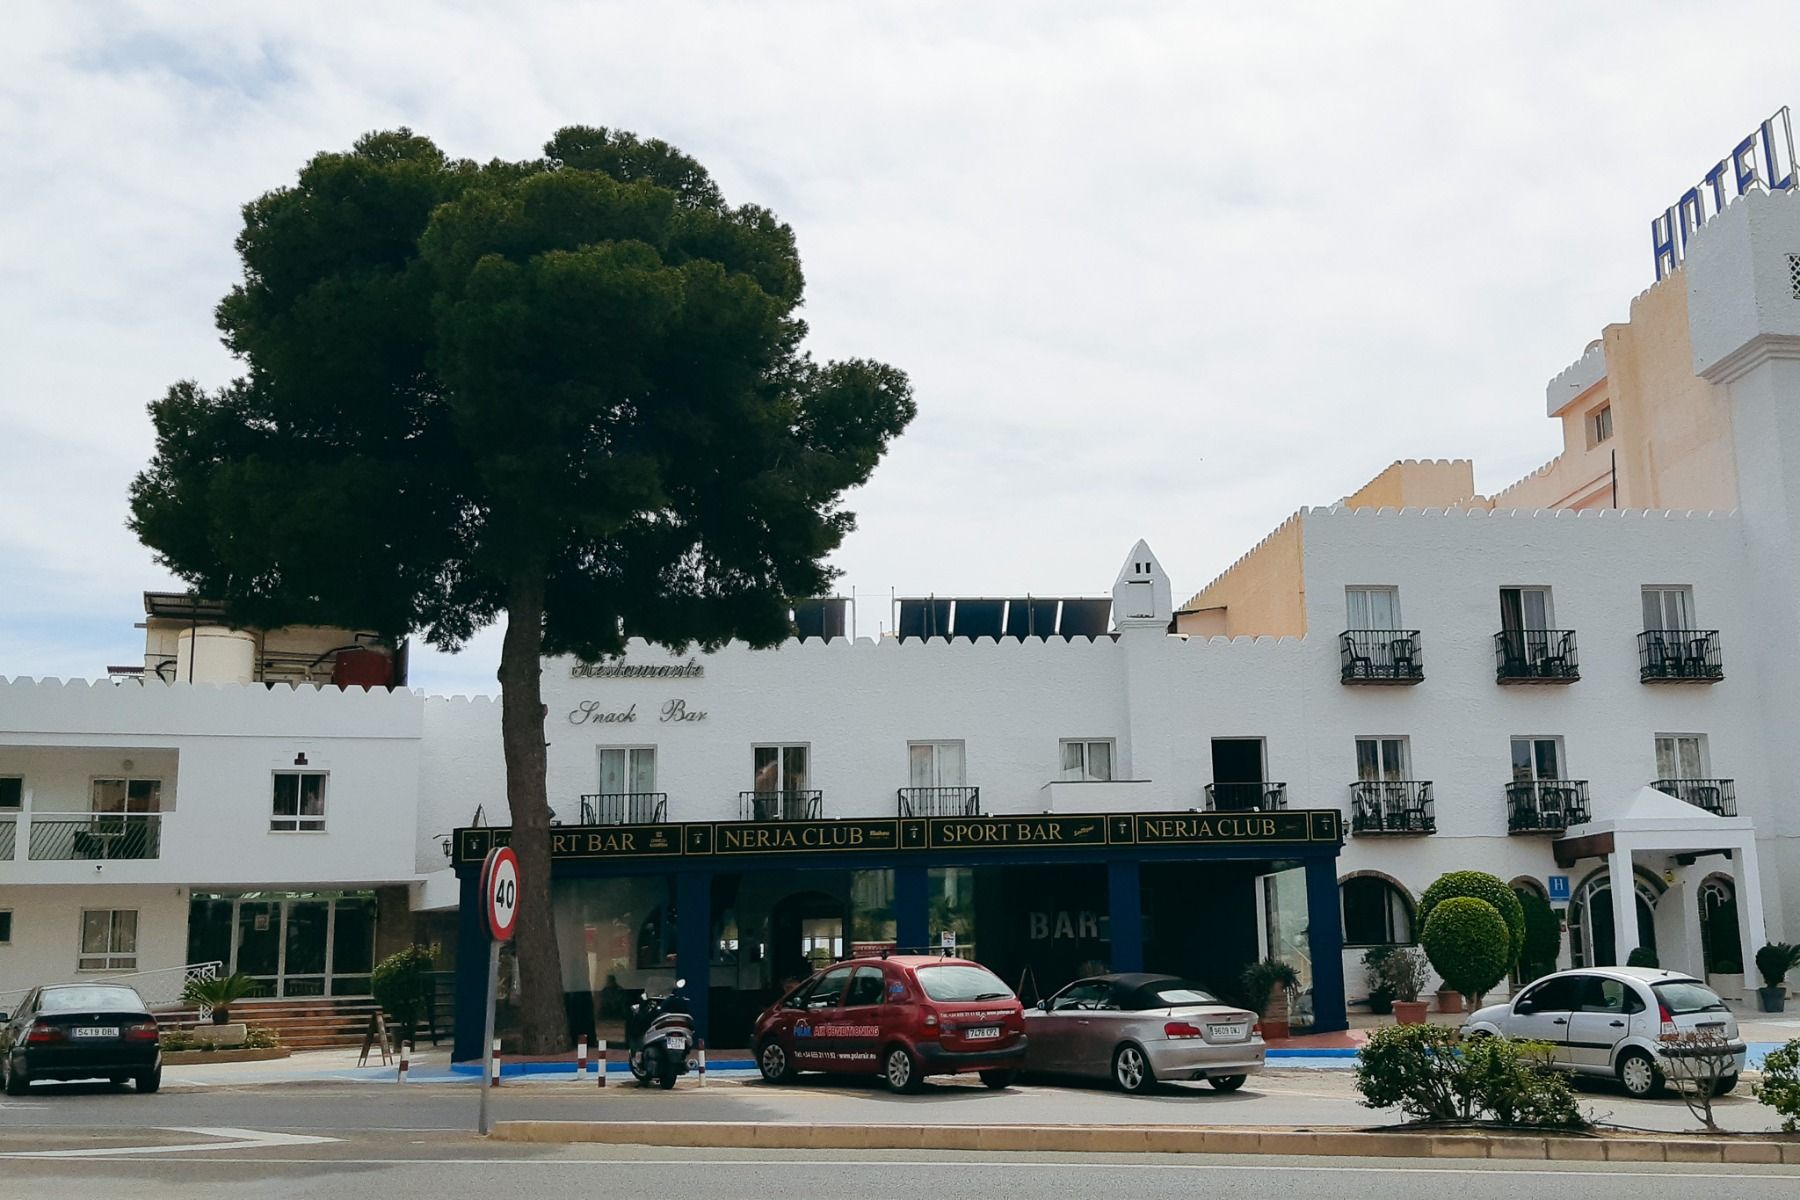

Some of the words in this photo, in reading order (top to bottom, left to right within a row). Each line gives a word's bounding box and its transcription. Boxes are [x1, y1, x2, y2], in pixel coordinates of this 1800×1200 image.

[1652, 118, 1797, 282] HOTEL
[569, 700, 636, 725] Snack
[660, 698, 708, 722] Bar
[725, 829, 798, 848] NERJA
[802, 827, 863, 846] CLUB
[943, 824, 1011, 842] SPORT
[1018, 823, 1062, 841] BAR
[1145, 820, 1213, 838] NERJA
[1217, 819, 1276, 837] CLUB
[588, 833, 636, 851] BAR
[496, 879, 514, 909] 40
[1553, 878, 1564, 890] H
[1029, 911, 1097, 939] BAR
[813, 1025, 825, 1037] AIR
[826, 1025, 879, 1037] CONDITIONING
